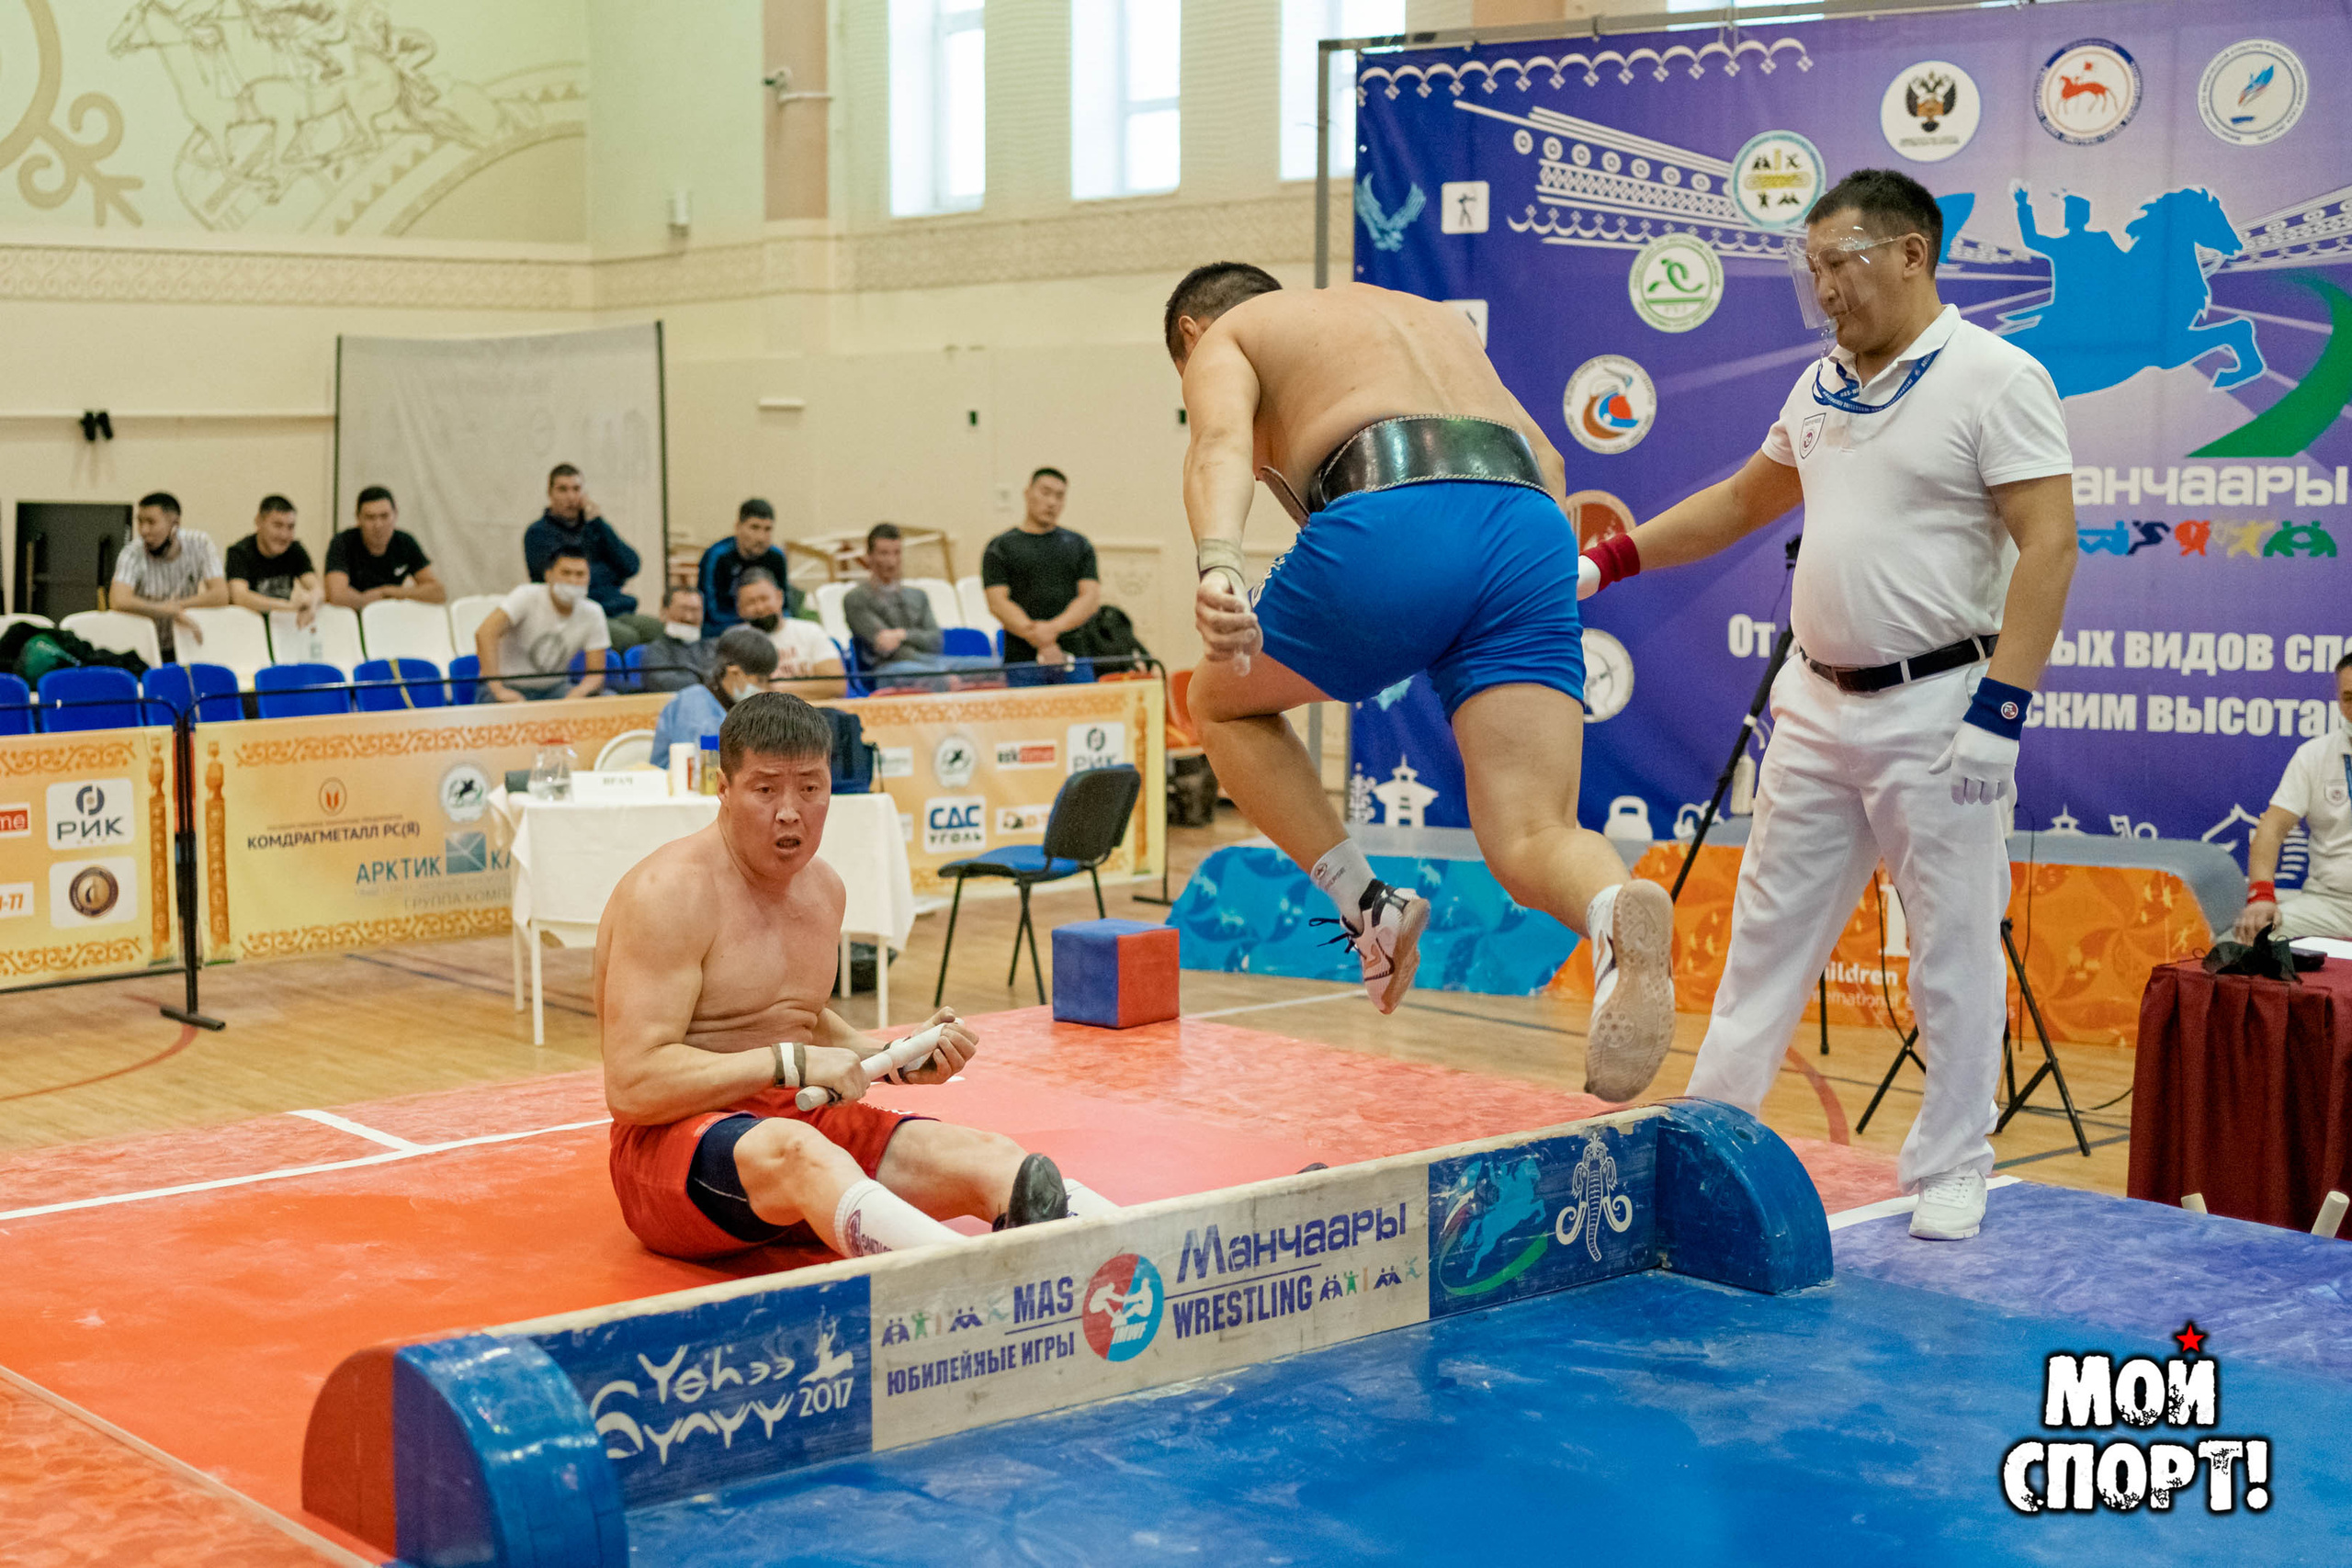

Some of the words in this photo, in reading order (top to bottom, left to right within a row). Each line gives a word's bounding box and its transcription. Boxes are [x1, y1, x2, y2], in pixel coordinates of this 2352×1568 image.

[2072, 466, 2348, 507] анчаары
[1728, 613, 1776, 658] От
[2046, 629, 2116, 668] ых
[2284, 633, 2352, 673] сп
[2022, 690, 2138, 732] ским
[57, 816, 123, 840] РИК
[247, 826, 379, 851] КОМДРАГМЕТАЛЛ
[356, 854, 441, 885] АРКТИК
[1176, 1201, 1407, 1284] Манчаары
[1013, 1276, 1074, 1325] MAS
[1171, 1274, 1313, 1340] WRESTLING
[887, 1344, 1017, 1397] ЮБИЛЕЙНЫЕ
[1022, 1332, 1075, 1367] ИГРЫ
[798, 1377, 854, 1417] 2017
